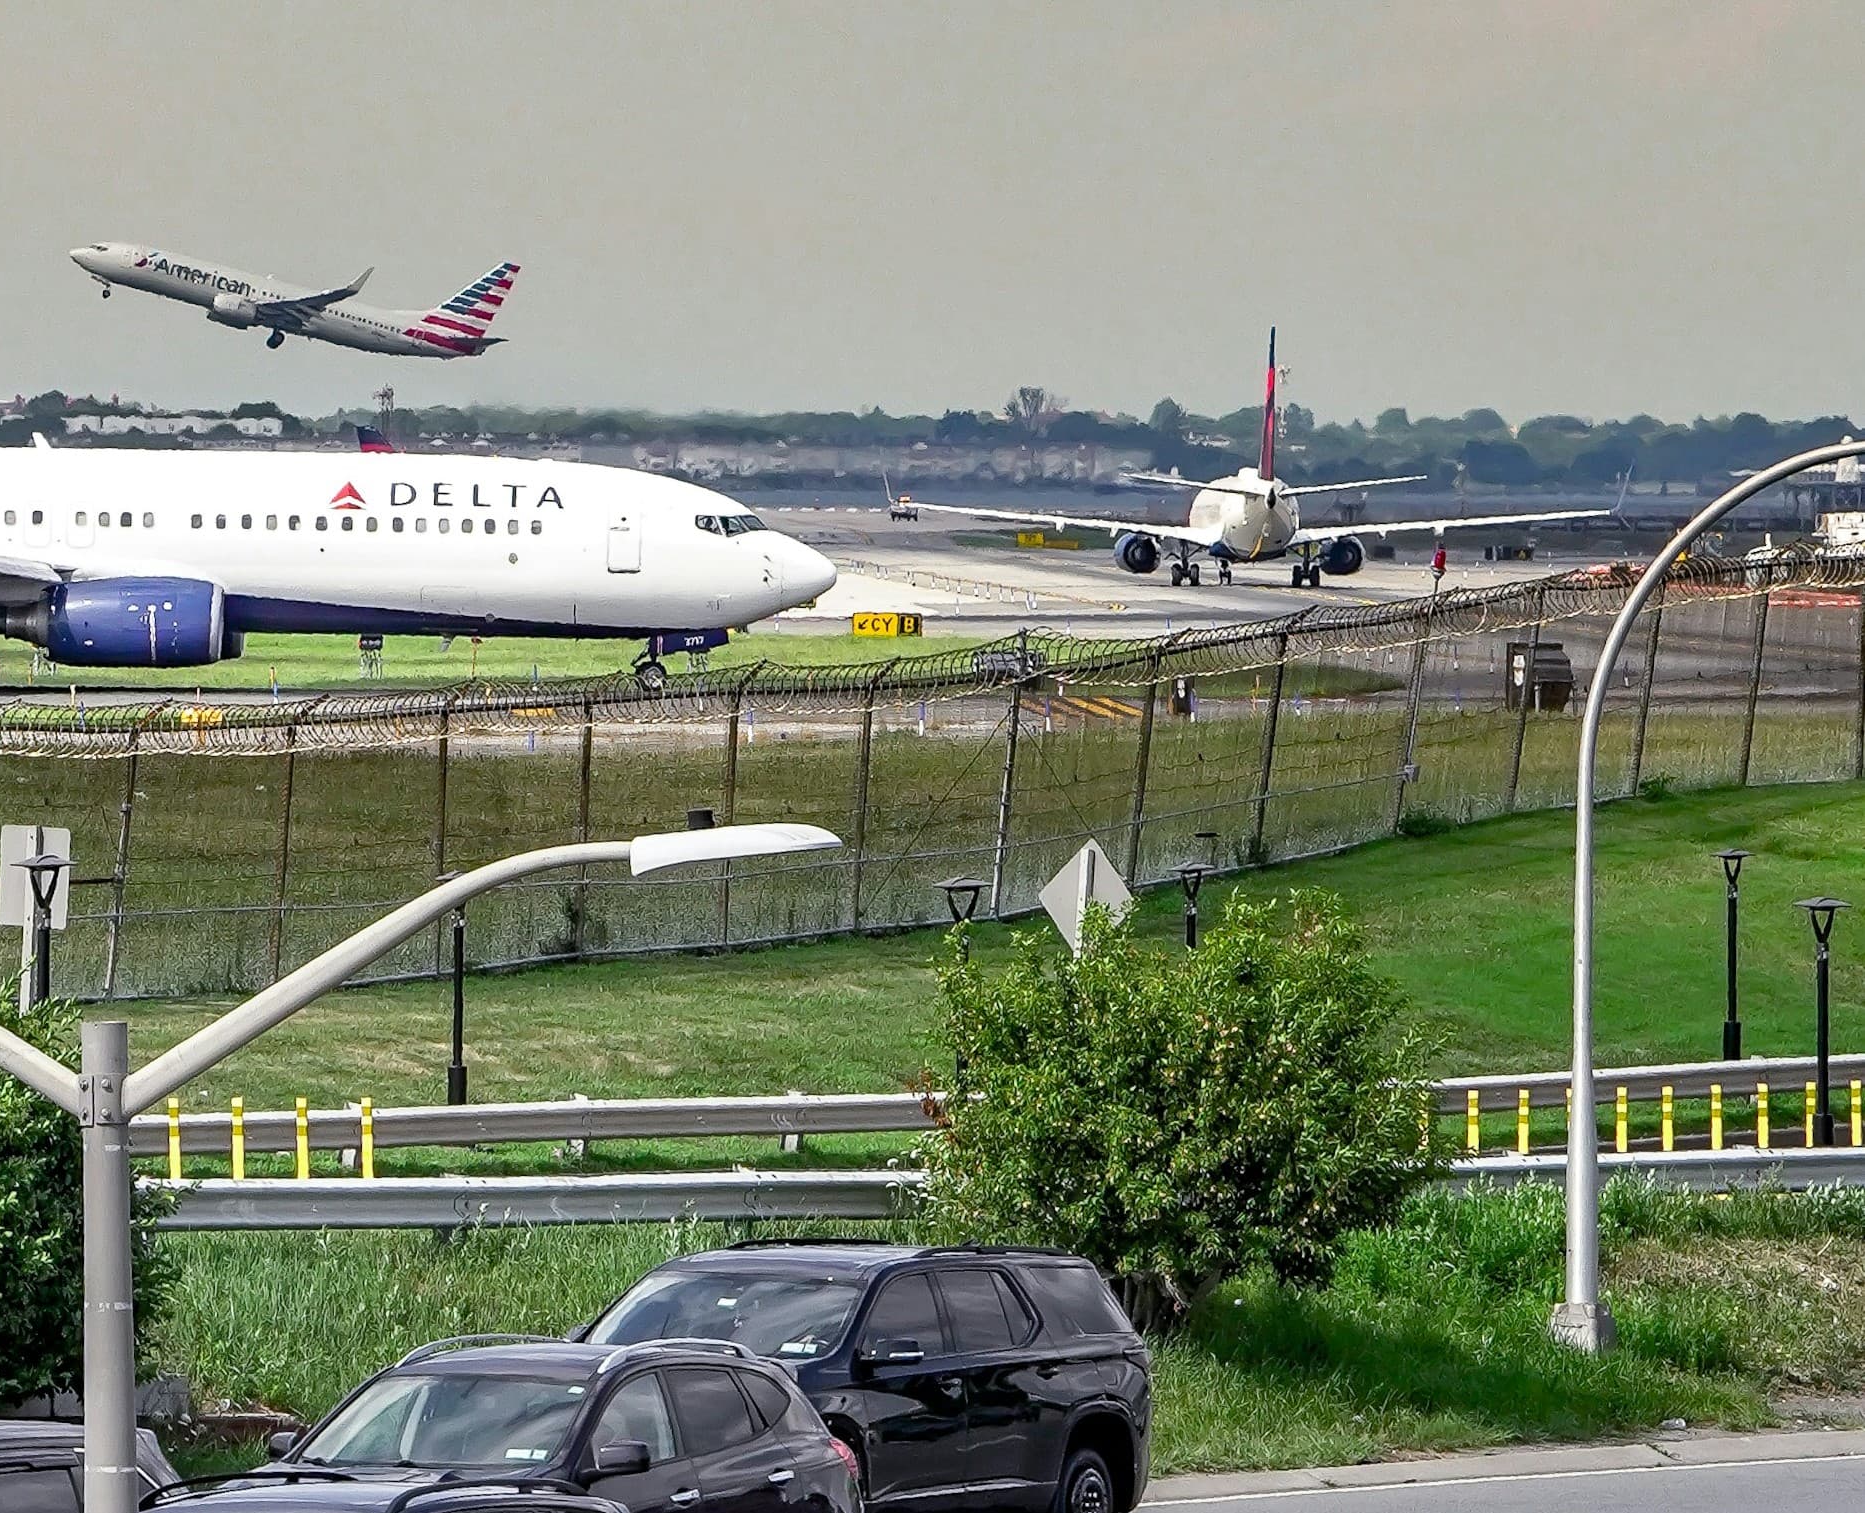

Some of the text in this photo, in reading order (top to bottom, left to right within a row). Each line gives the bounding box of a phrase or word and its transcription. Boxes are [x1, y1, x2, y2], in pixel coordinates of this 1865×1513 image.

[152, 258, 252, 297] American
[389, 482, 565, 510] DELTA
[871, 615, 915, 633] CY B
